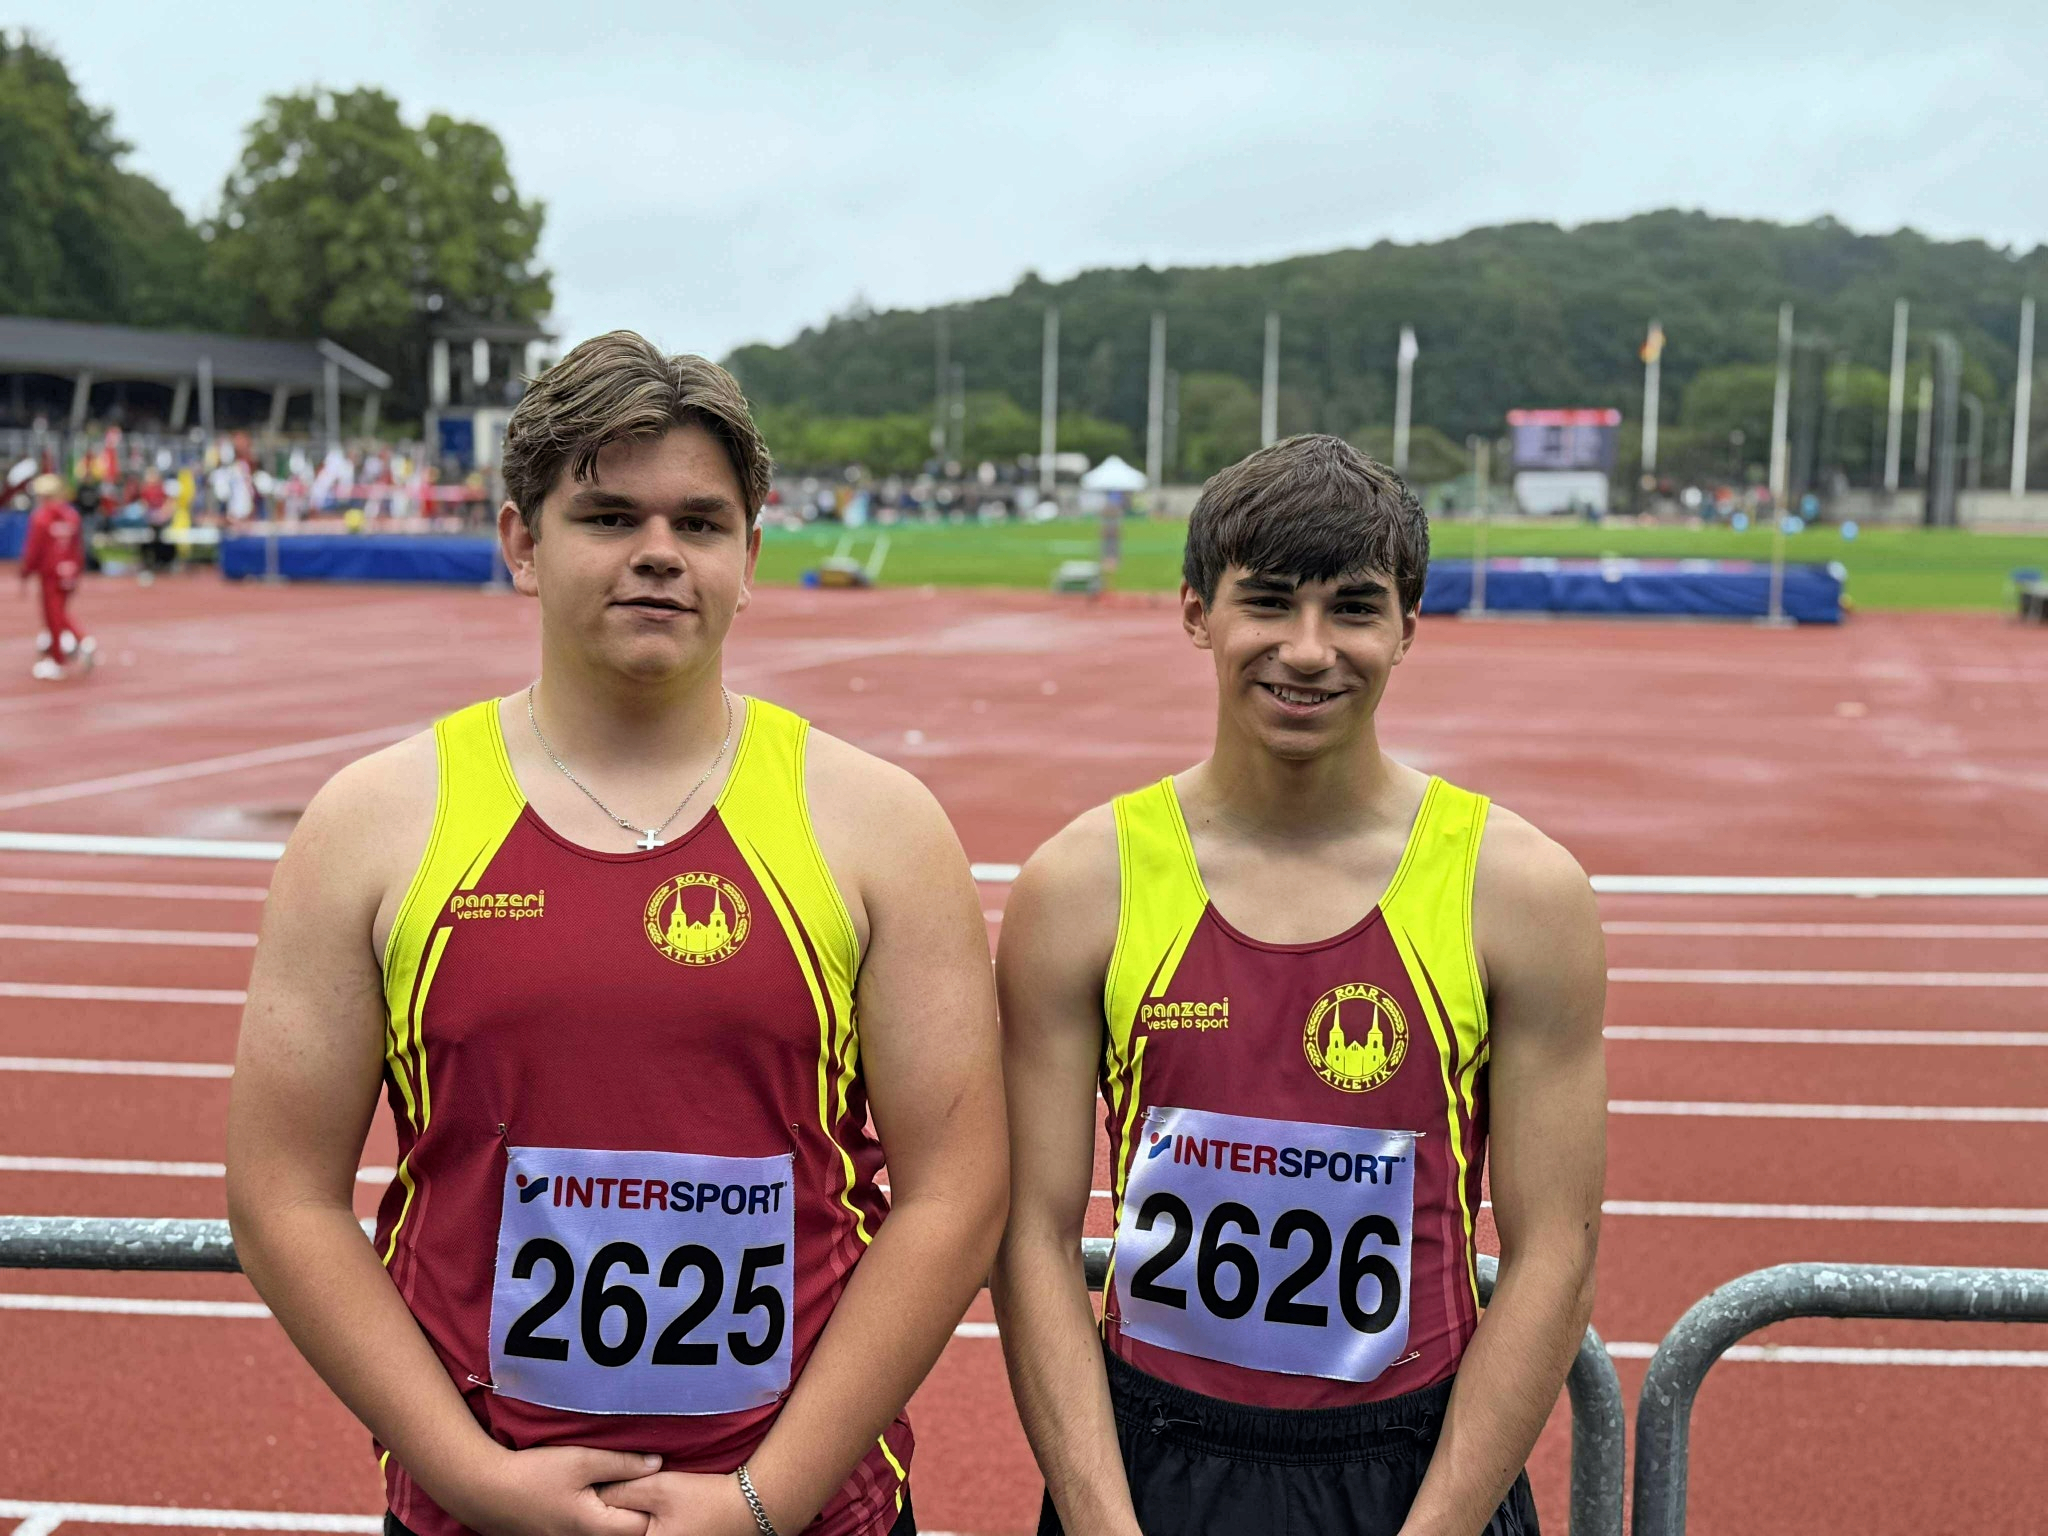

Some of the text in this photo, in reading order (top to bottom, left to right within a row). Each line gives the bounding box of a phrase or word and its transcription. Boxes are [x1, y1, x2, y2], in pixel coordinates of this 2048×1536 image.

[675, 873, 720, 888] ROAR
[450, 889, 545, 913] panzeri
[457, 907, 544, 921] veste lo sport
[660, 940, 738, 964] ATLETIK
[1334, 985, 1380, 1001] ROAR
[1141, 996, 1229, 1023] panzeri
[1147, 1017, 1229, 1032] veste lo sport
[1319, 1065, 1393, 1090] ATLETIK
[1173, 1133, 1400, 1185] INTERSPORT
[553, 1175, 785, 1215] INTERSPORT
[1130, 1192, 1401, 1334] 2626
[503, 1237, 786, 1368] 2625
